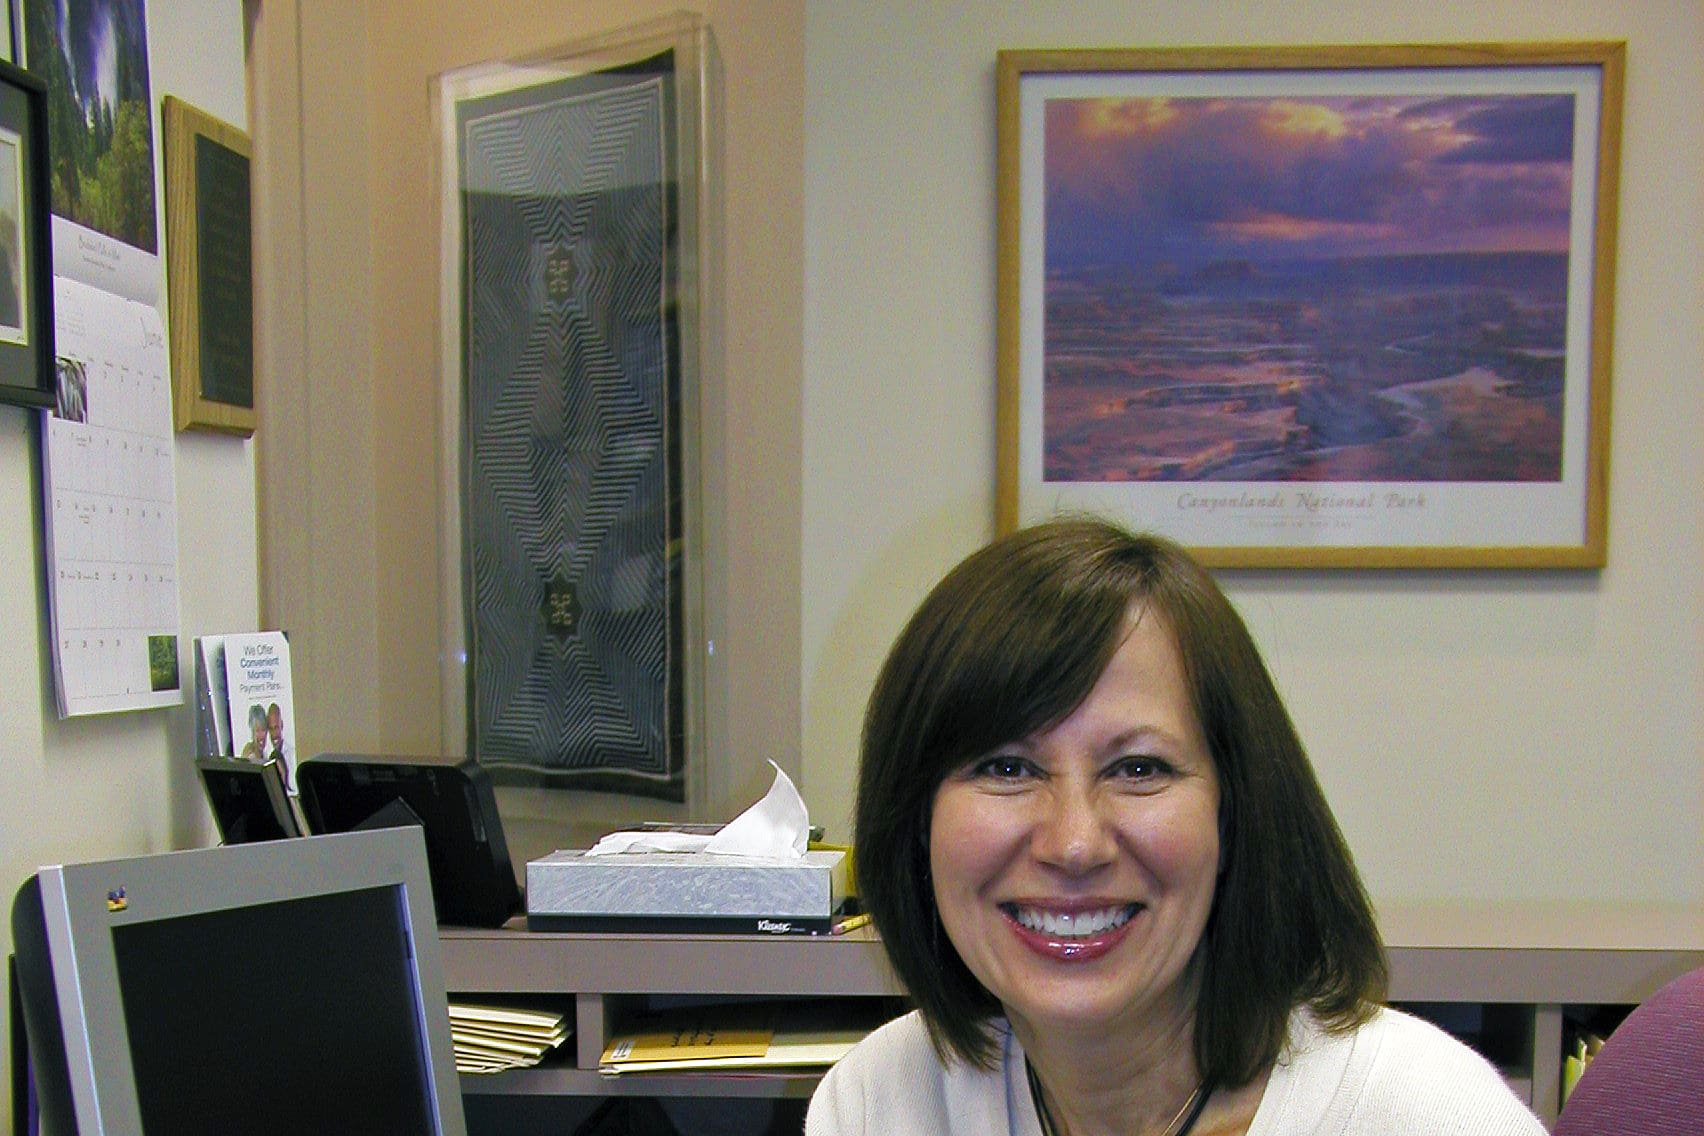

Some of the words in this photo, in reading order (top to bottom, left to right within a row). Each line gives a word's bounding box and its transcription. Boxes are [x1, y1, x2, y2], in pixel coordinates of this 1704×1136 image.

[1295, 492, 1374, 513] National
[1383, 492, 1427, 509] Park
[240, 657, 280, 669] Convenient
[247, 669, 275, 681] Monthly
